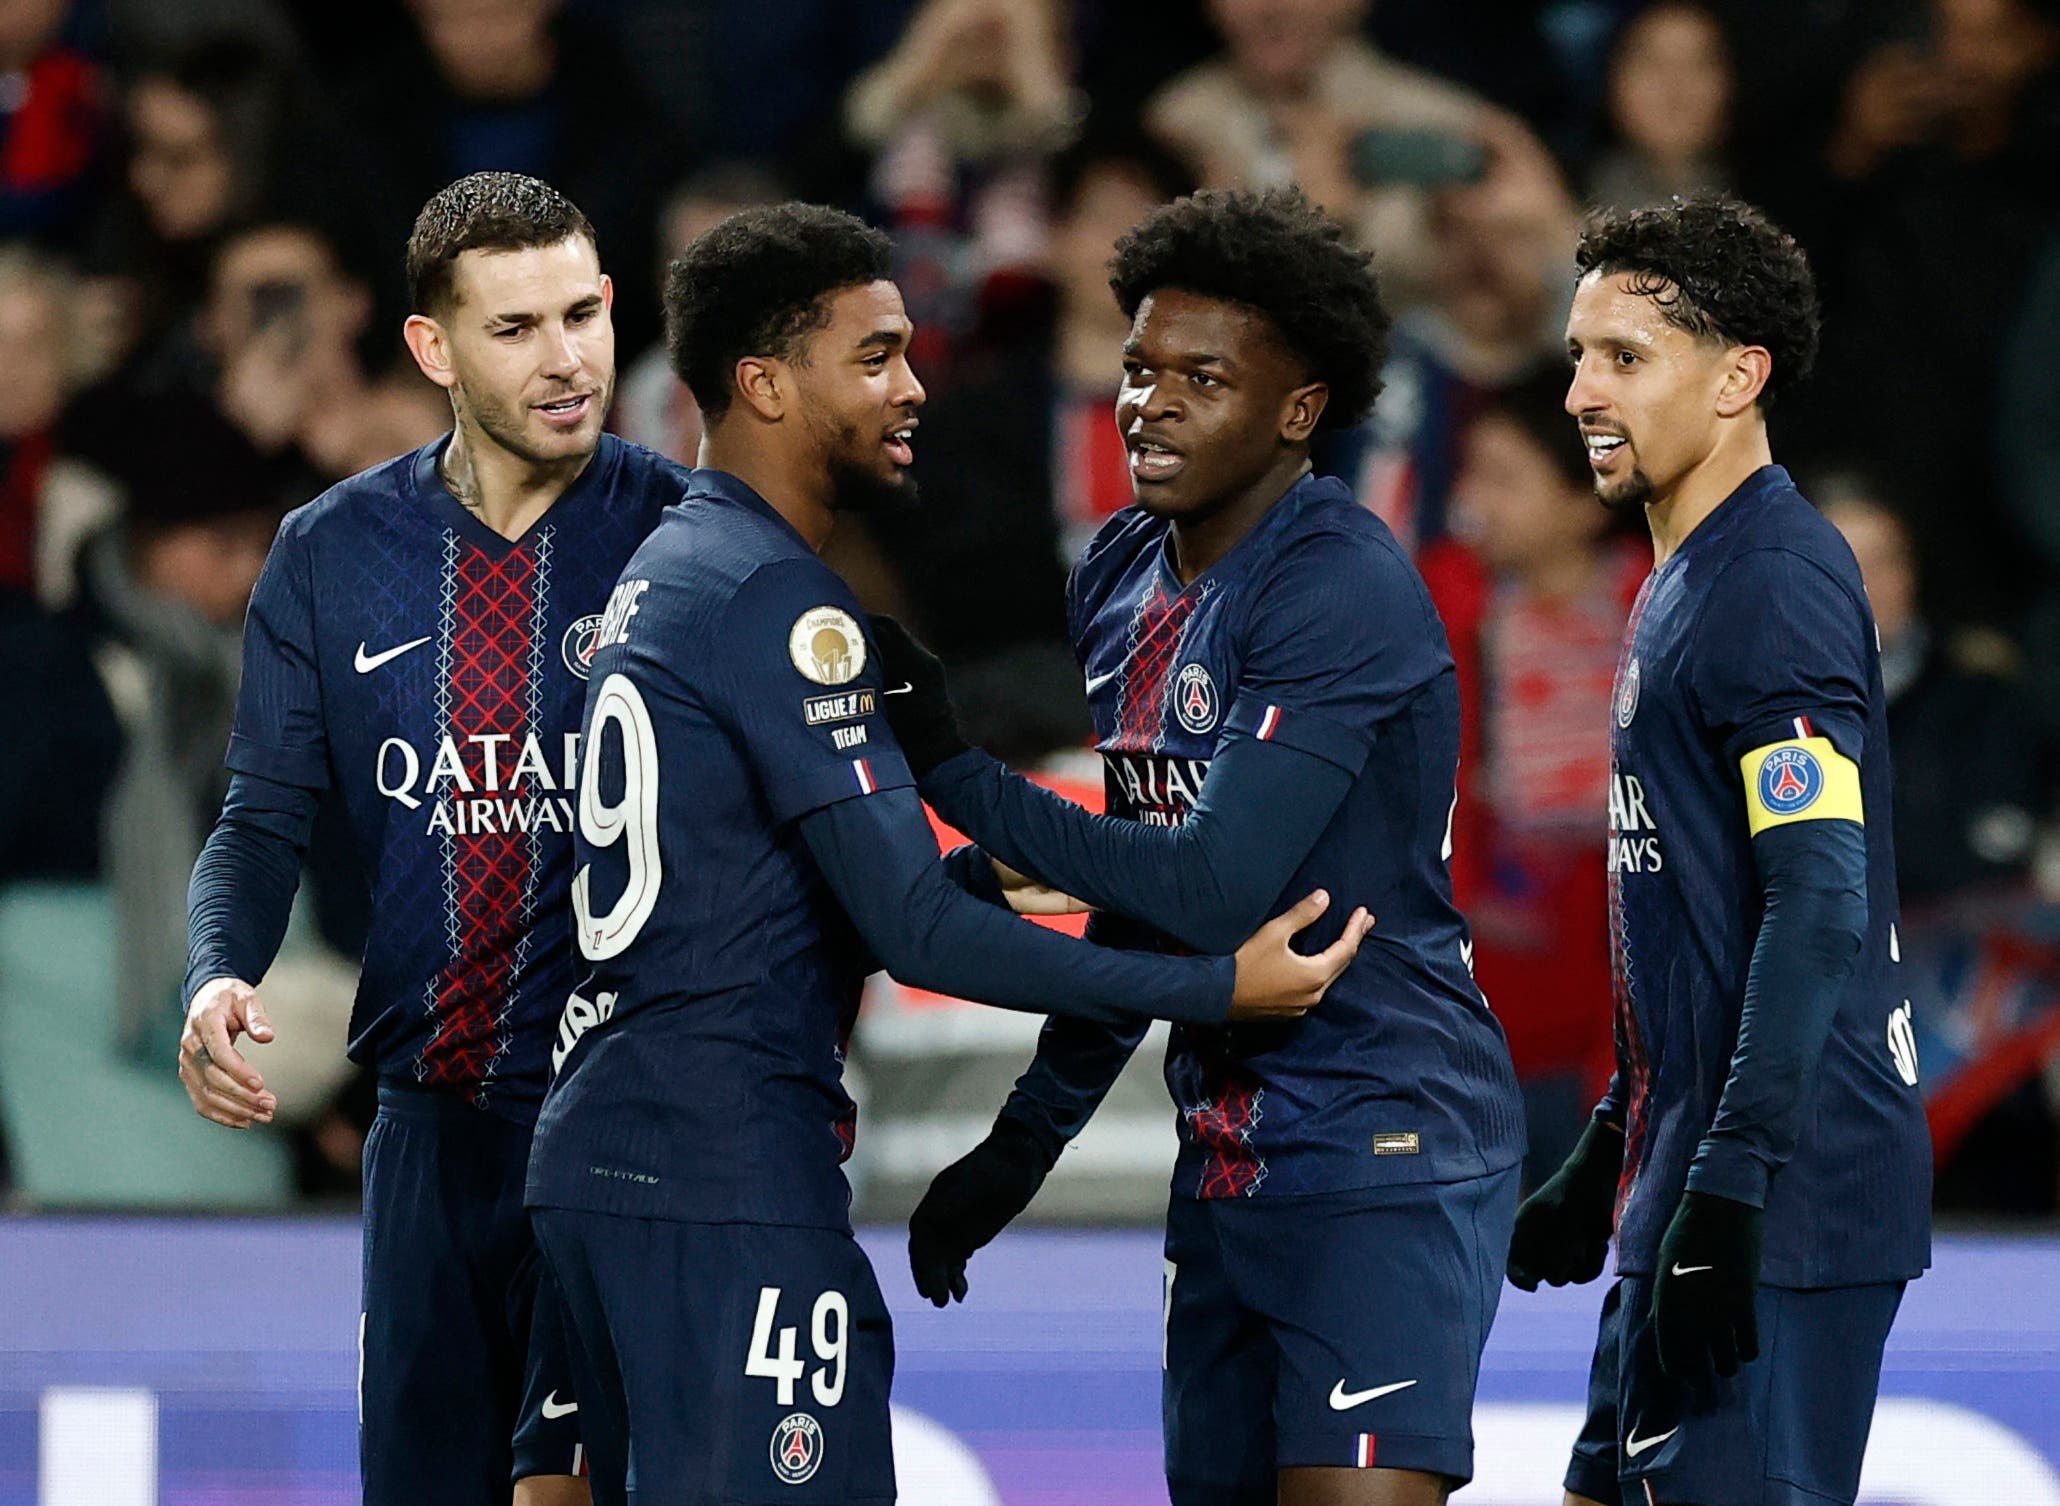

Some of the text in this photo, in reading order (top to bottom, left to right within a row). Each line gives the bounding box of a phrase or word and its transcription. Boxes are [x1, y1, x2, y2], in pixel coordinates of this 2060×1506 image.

[1765, 752, 1808, 772] PARIS
[744, 1287, 848, 1408] 49
[781, 1416, 816, 1435] PARIS
